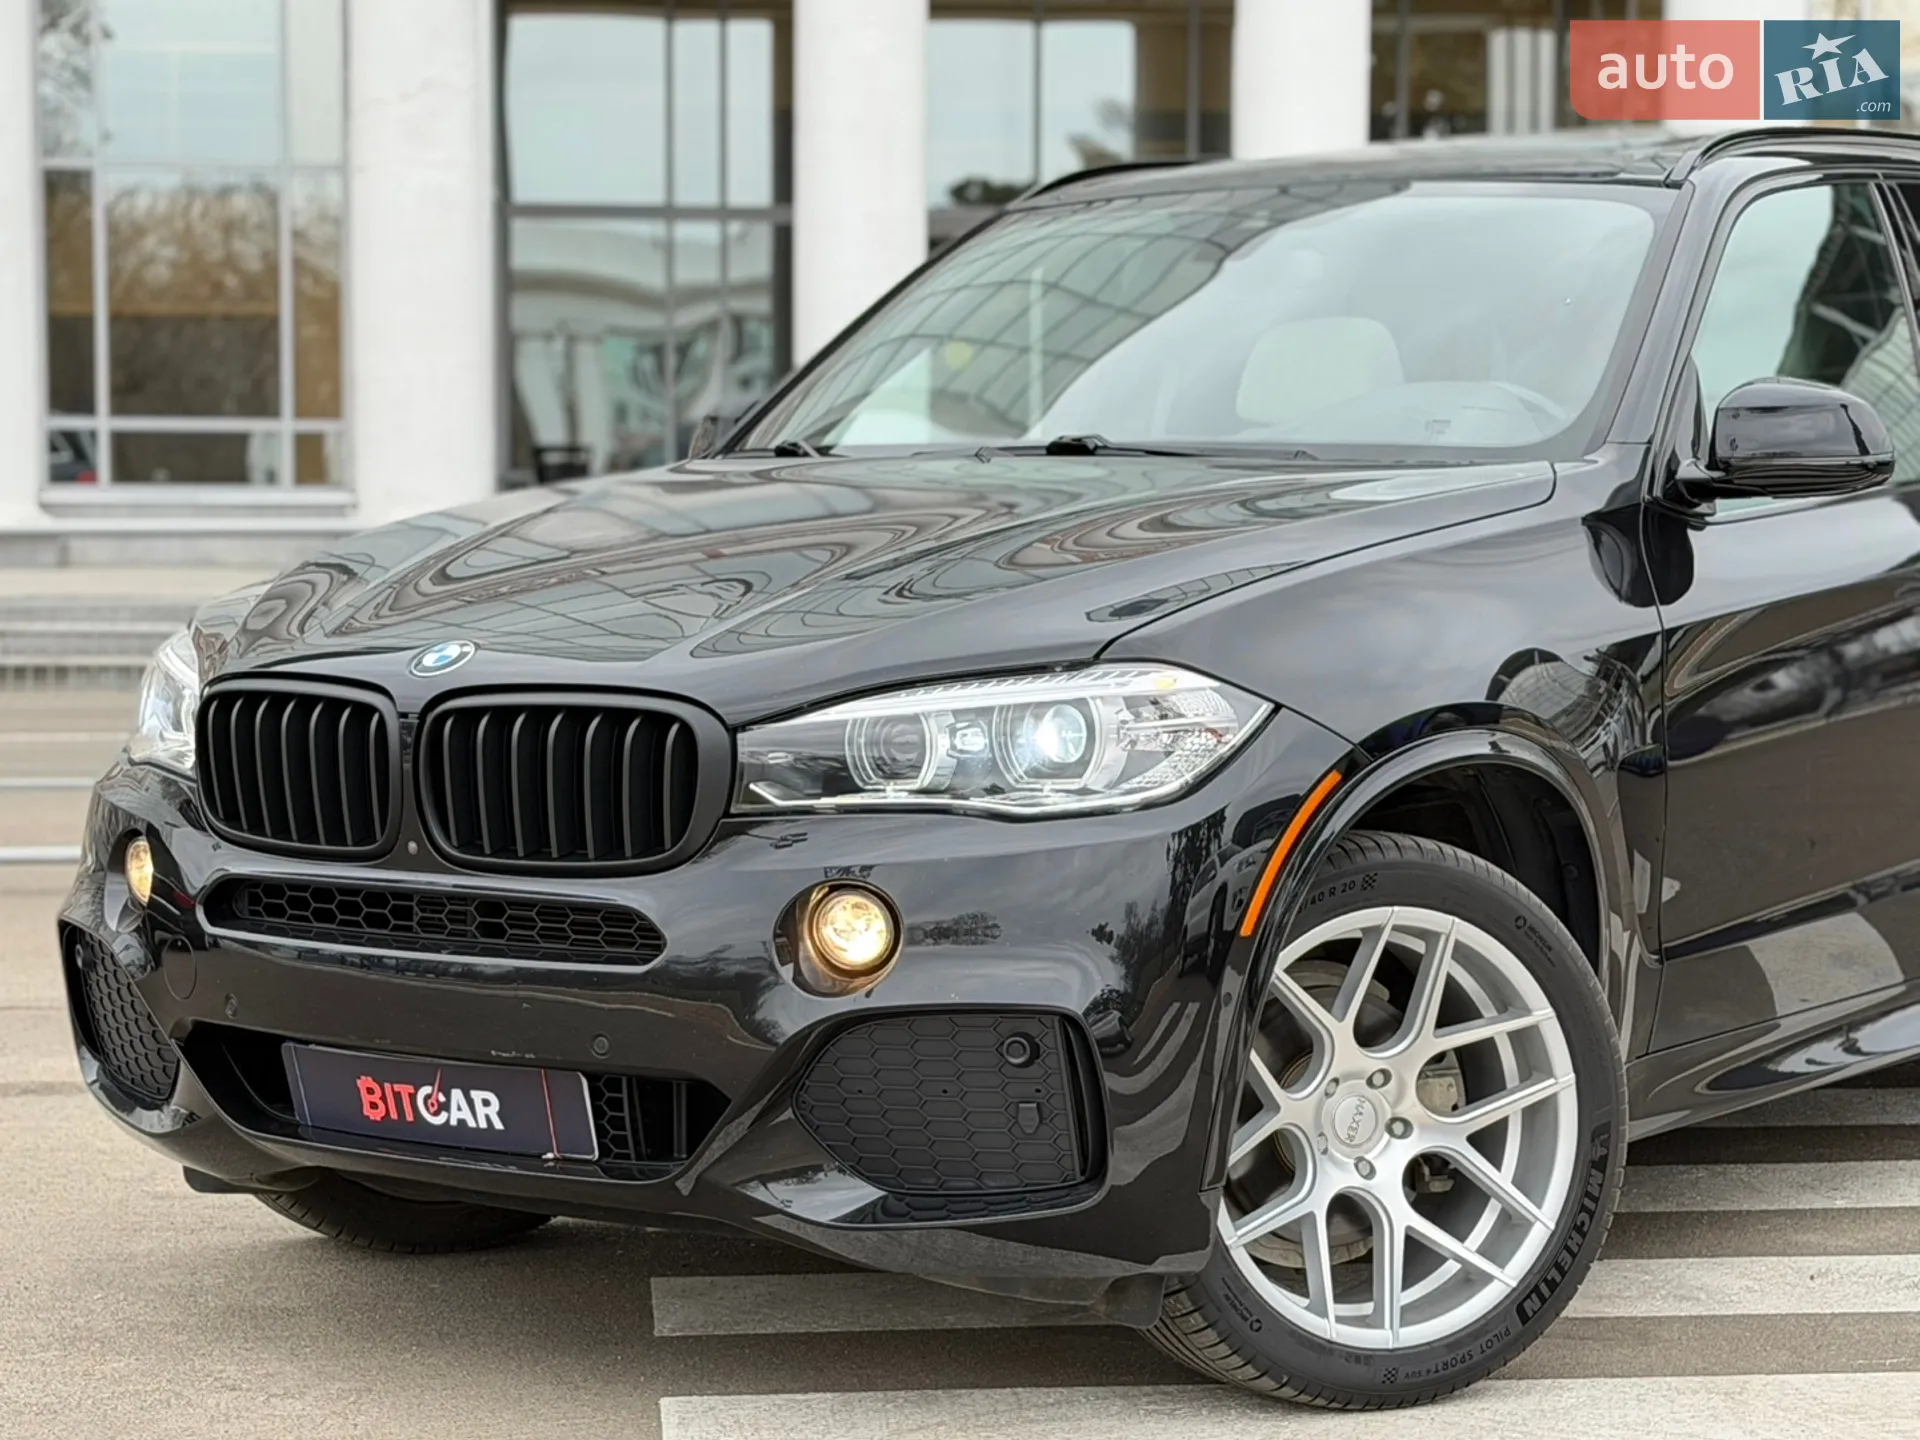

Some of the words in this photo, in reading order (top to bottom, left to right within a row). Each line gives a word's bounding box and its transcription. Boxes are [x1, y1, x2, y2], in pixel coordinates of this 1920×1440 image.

[1341, 880, 1356, 893] 20
[357, 1075, 505, 1131] BITCAR
[1523, 1168, 1604, 1318] MICHELIN
[1480, 1325, 1511, 1355] PILOT
[1433, 1349, 1474, 1374] SPORT
